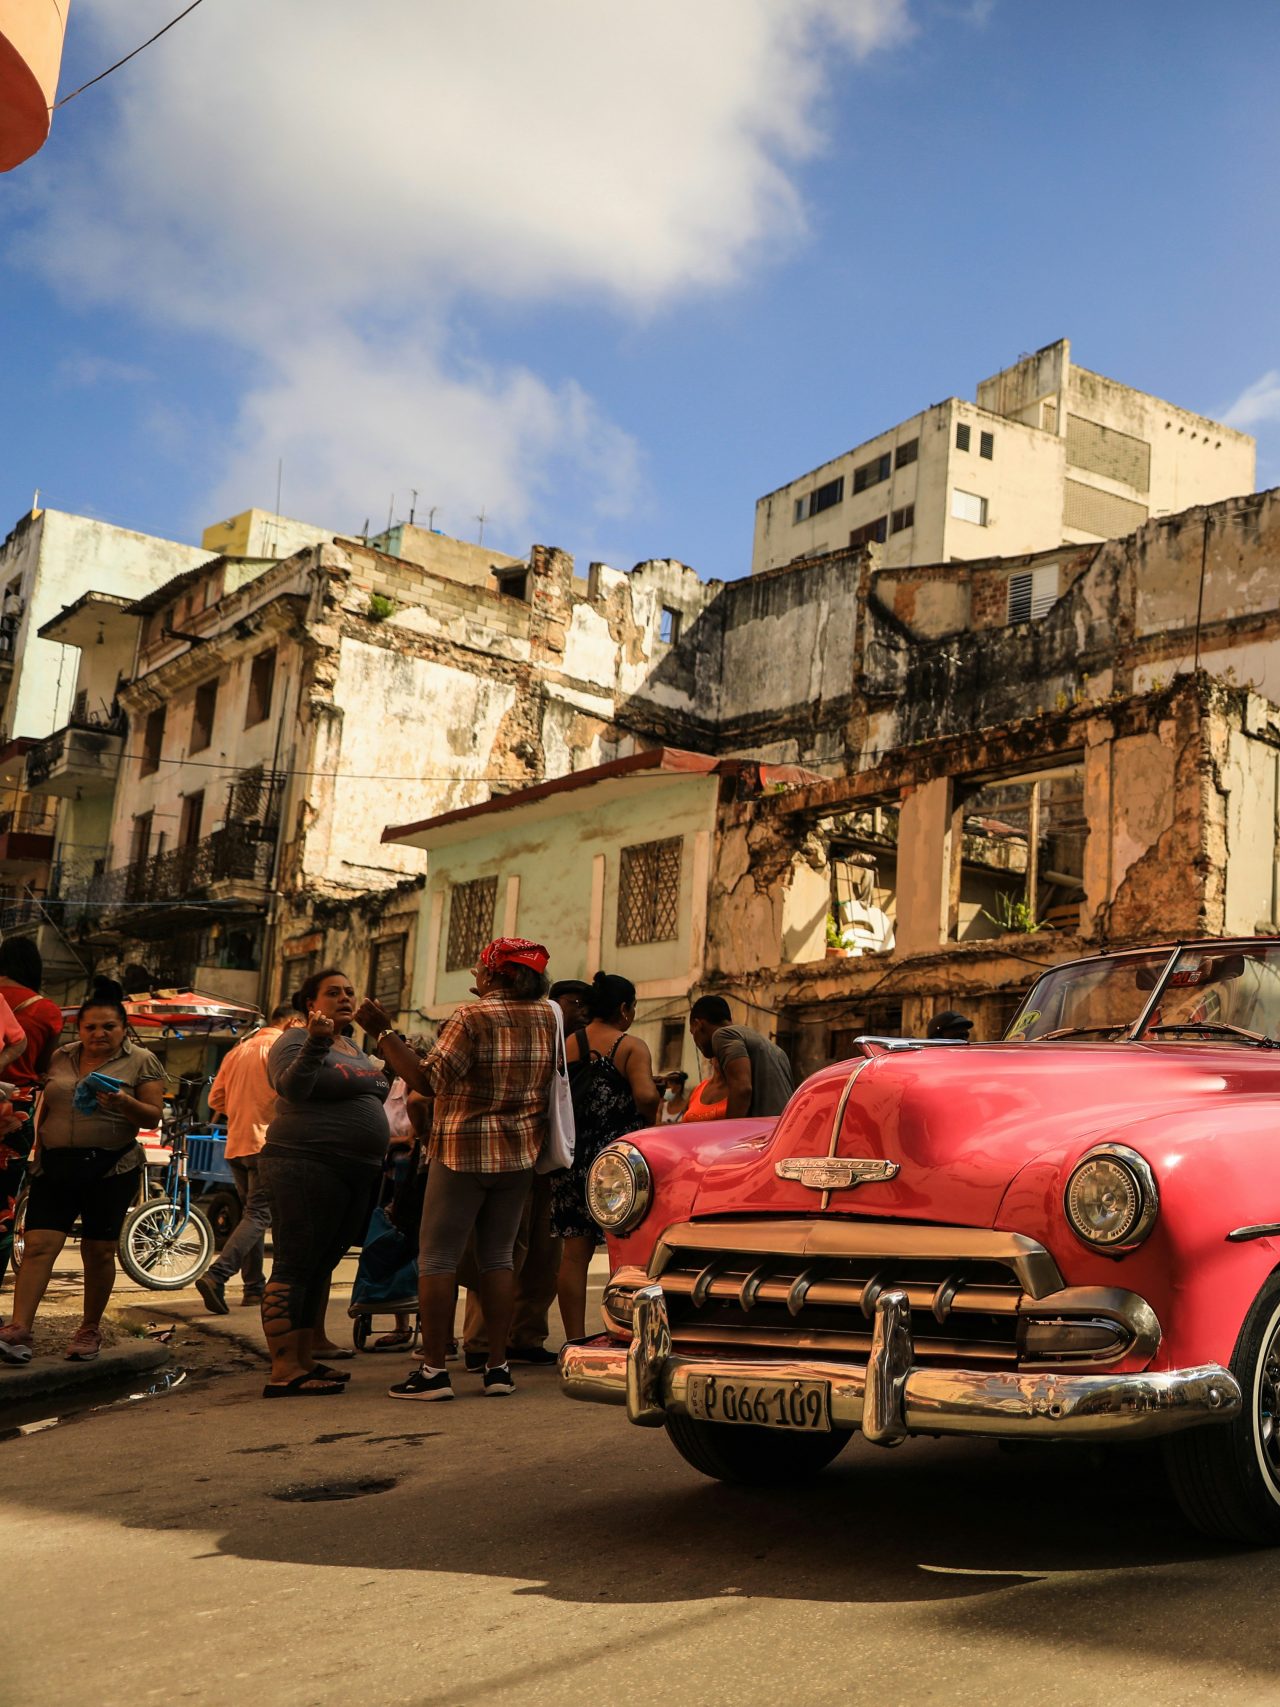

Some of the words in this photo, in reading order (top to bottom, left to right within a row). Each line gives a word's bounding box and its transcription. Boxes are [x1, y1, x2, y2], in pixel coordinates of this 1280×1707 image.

[704, 1382, 716, 1419] P
[722, 1385, 769, 1423] 066
[773, 1387, 822, 1427] 109
